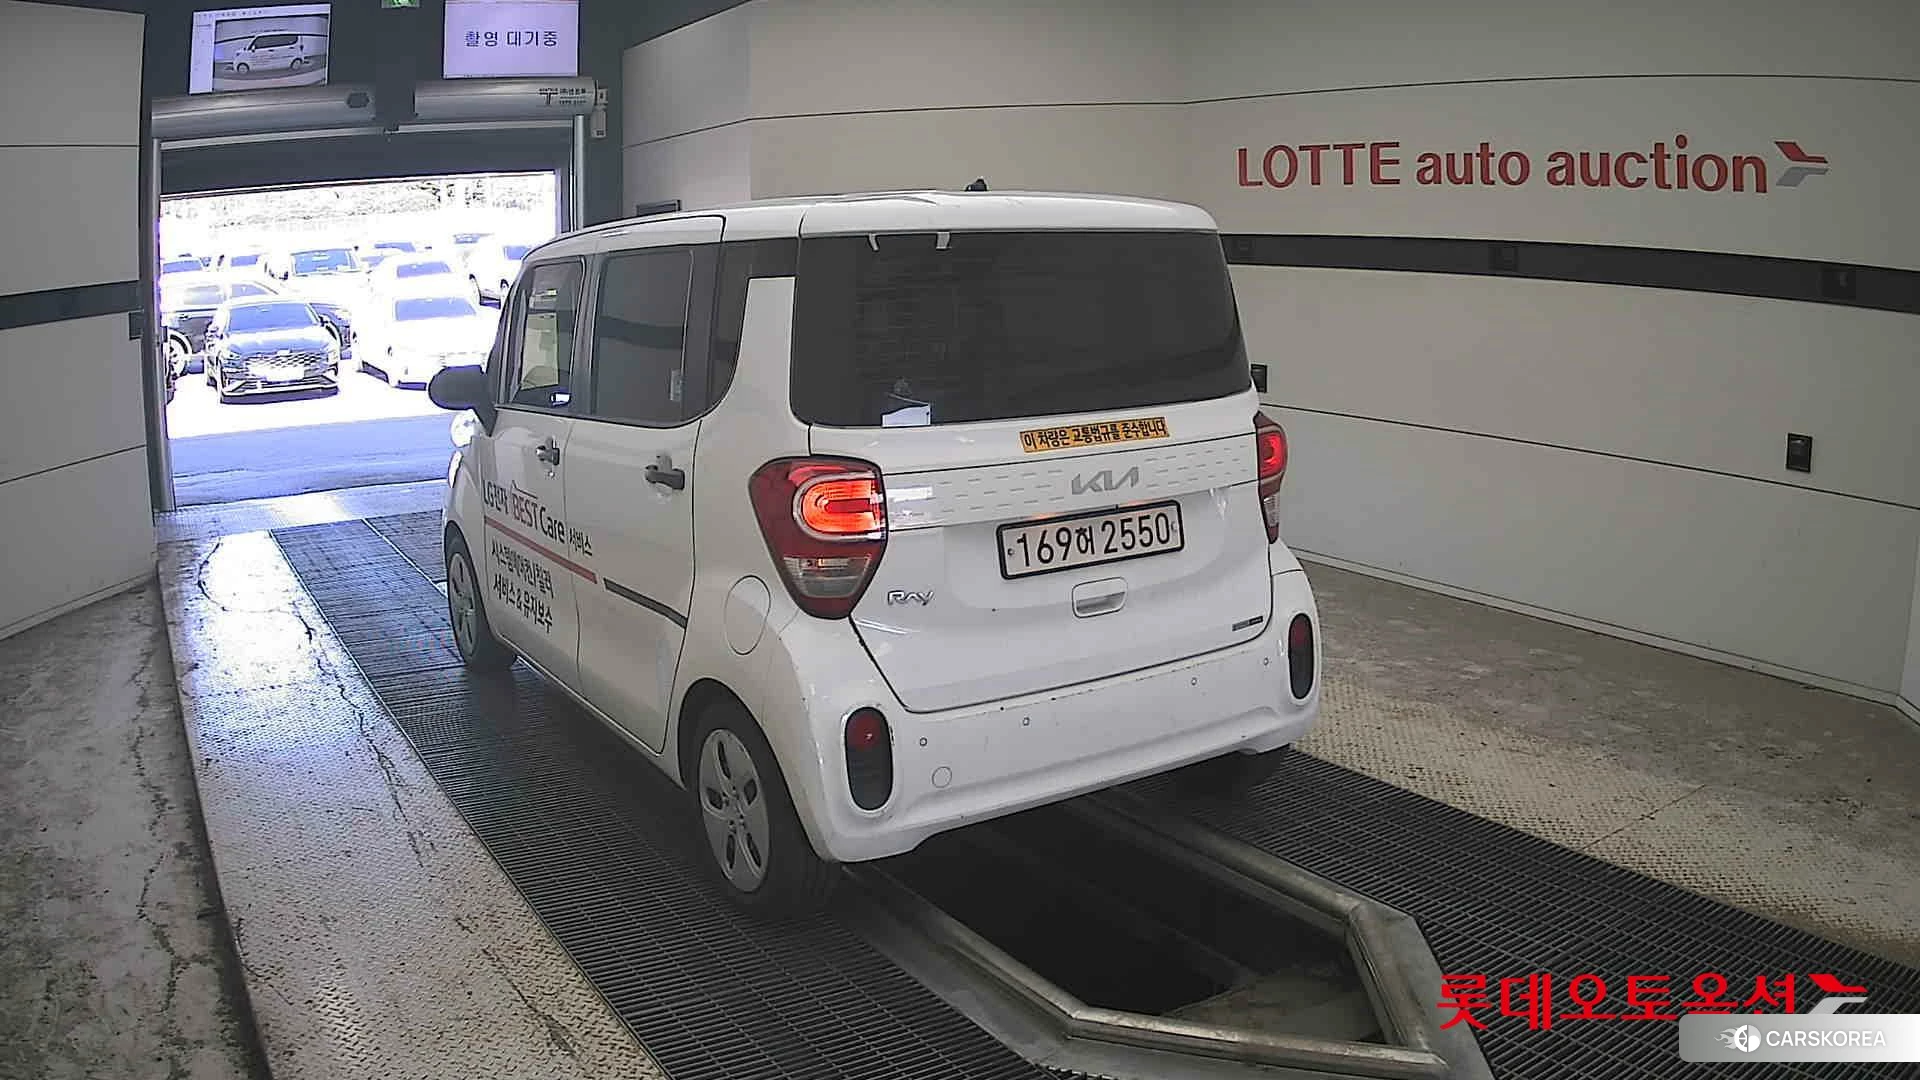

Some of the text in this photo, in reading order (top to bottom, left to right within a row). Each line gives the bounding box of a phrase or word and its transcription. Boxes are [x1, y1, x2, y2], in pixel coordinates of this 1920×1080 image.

[506, 31, 557, 47] 대기중
[1238, 134, 1768, 194] LOTTE auto auction
[1024, 418, 1166, 449] 이 차량은 교통법규를 준수합니다
[511, 493, 538, 530] BEST
[539, 504, 566, 545] Care
[569, 526, 593, 557] 서비스
[1016, 511, 1170, 568] 169허 2550
